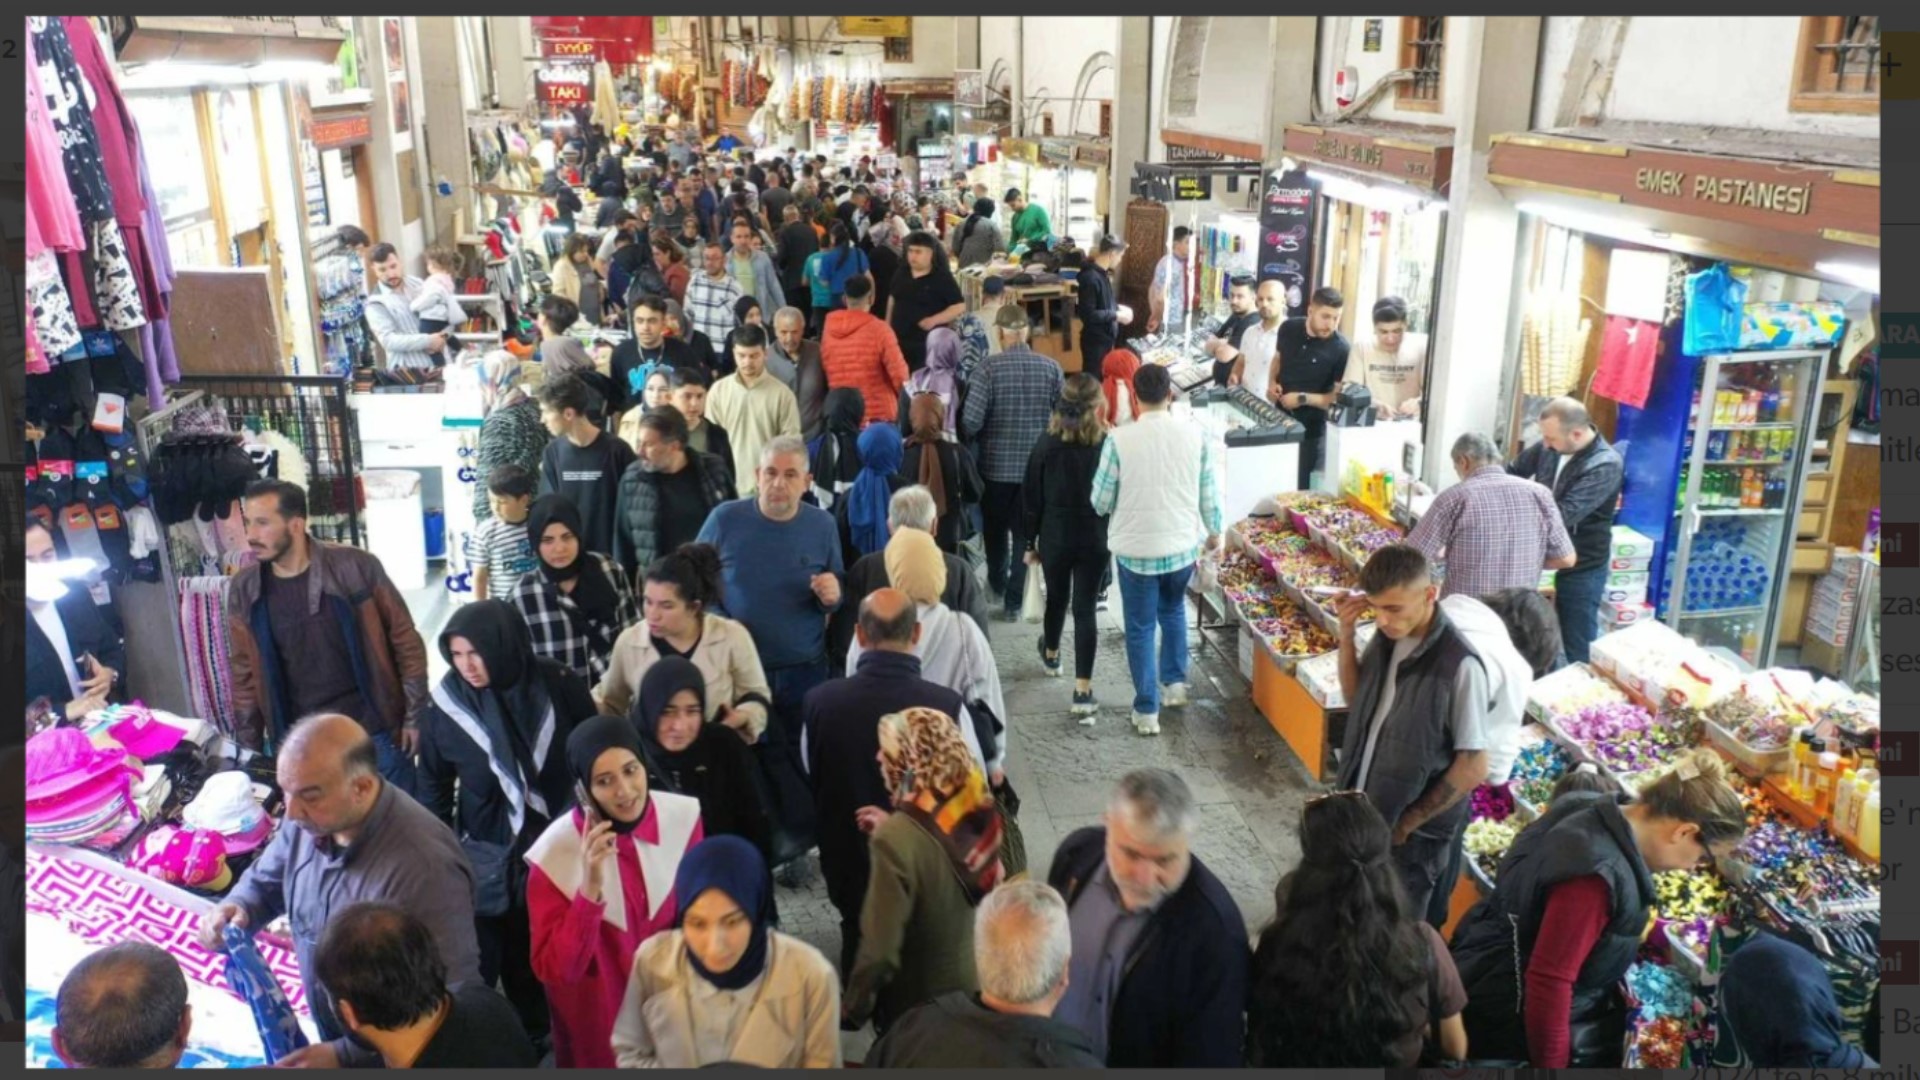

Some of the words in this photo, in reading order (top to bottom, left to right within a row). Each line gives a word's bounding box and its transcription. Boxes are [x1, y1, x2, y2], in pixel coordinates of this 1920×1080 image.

[548, 86, 581, 99] TAKI
[1636, 168, 1684, 196] EMEK
[1693, 175, 1812, 215] PASTANESİ
